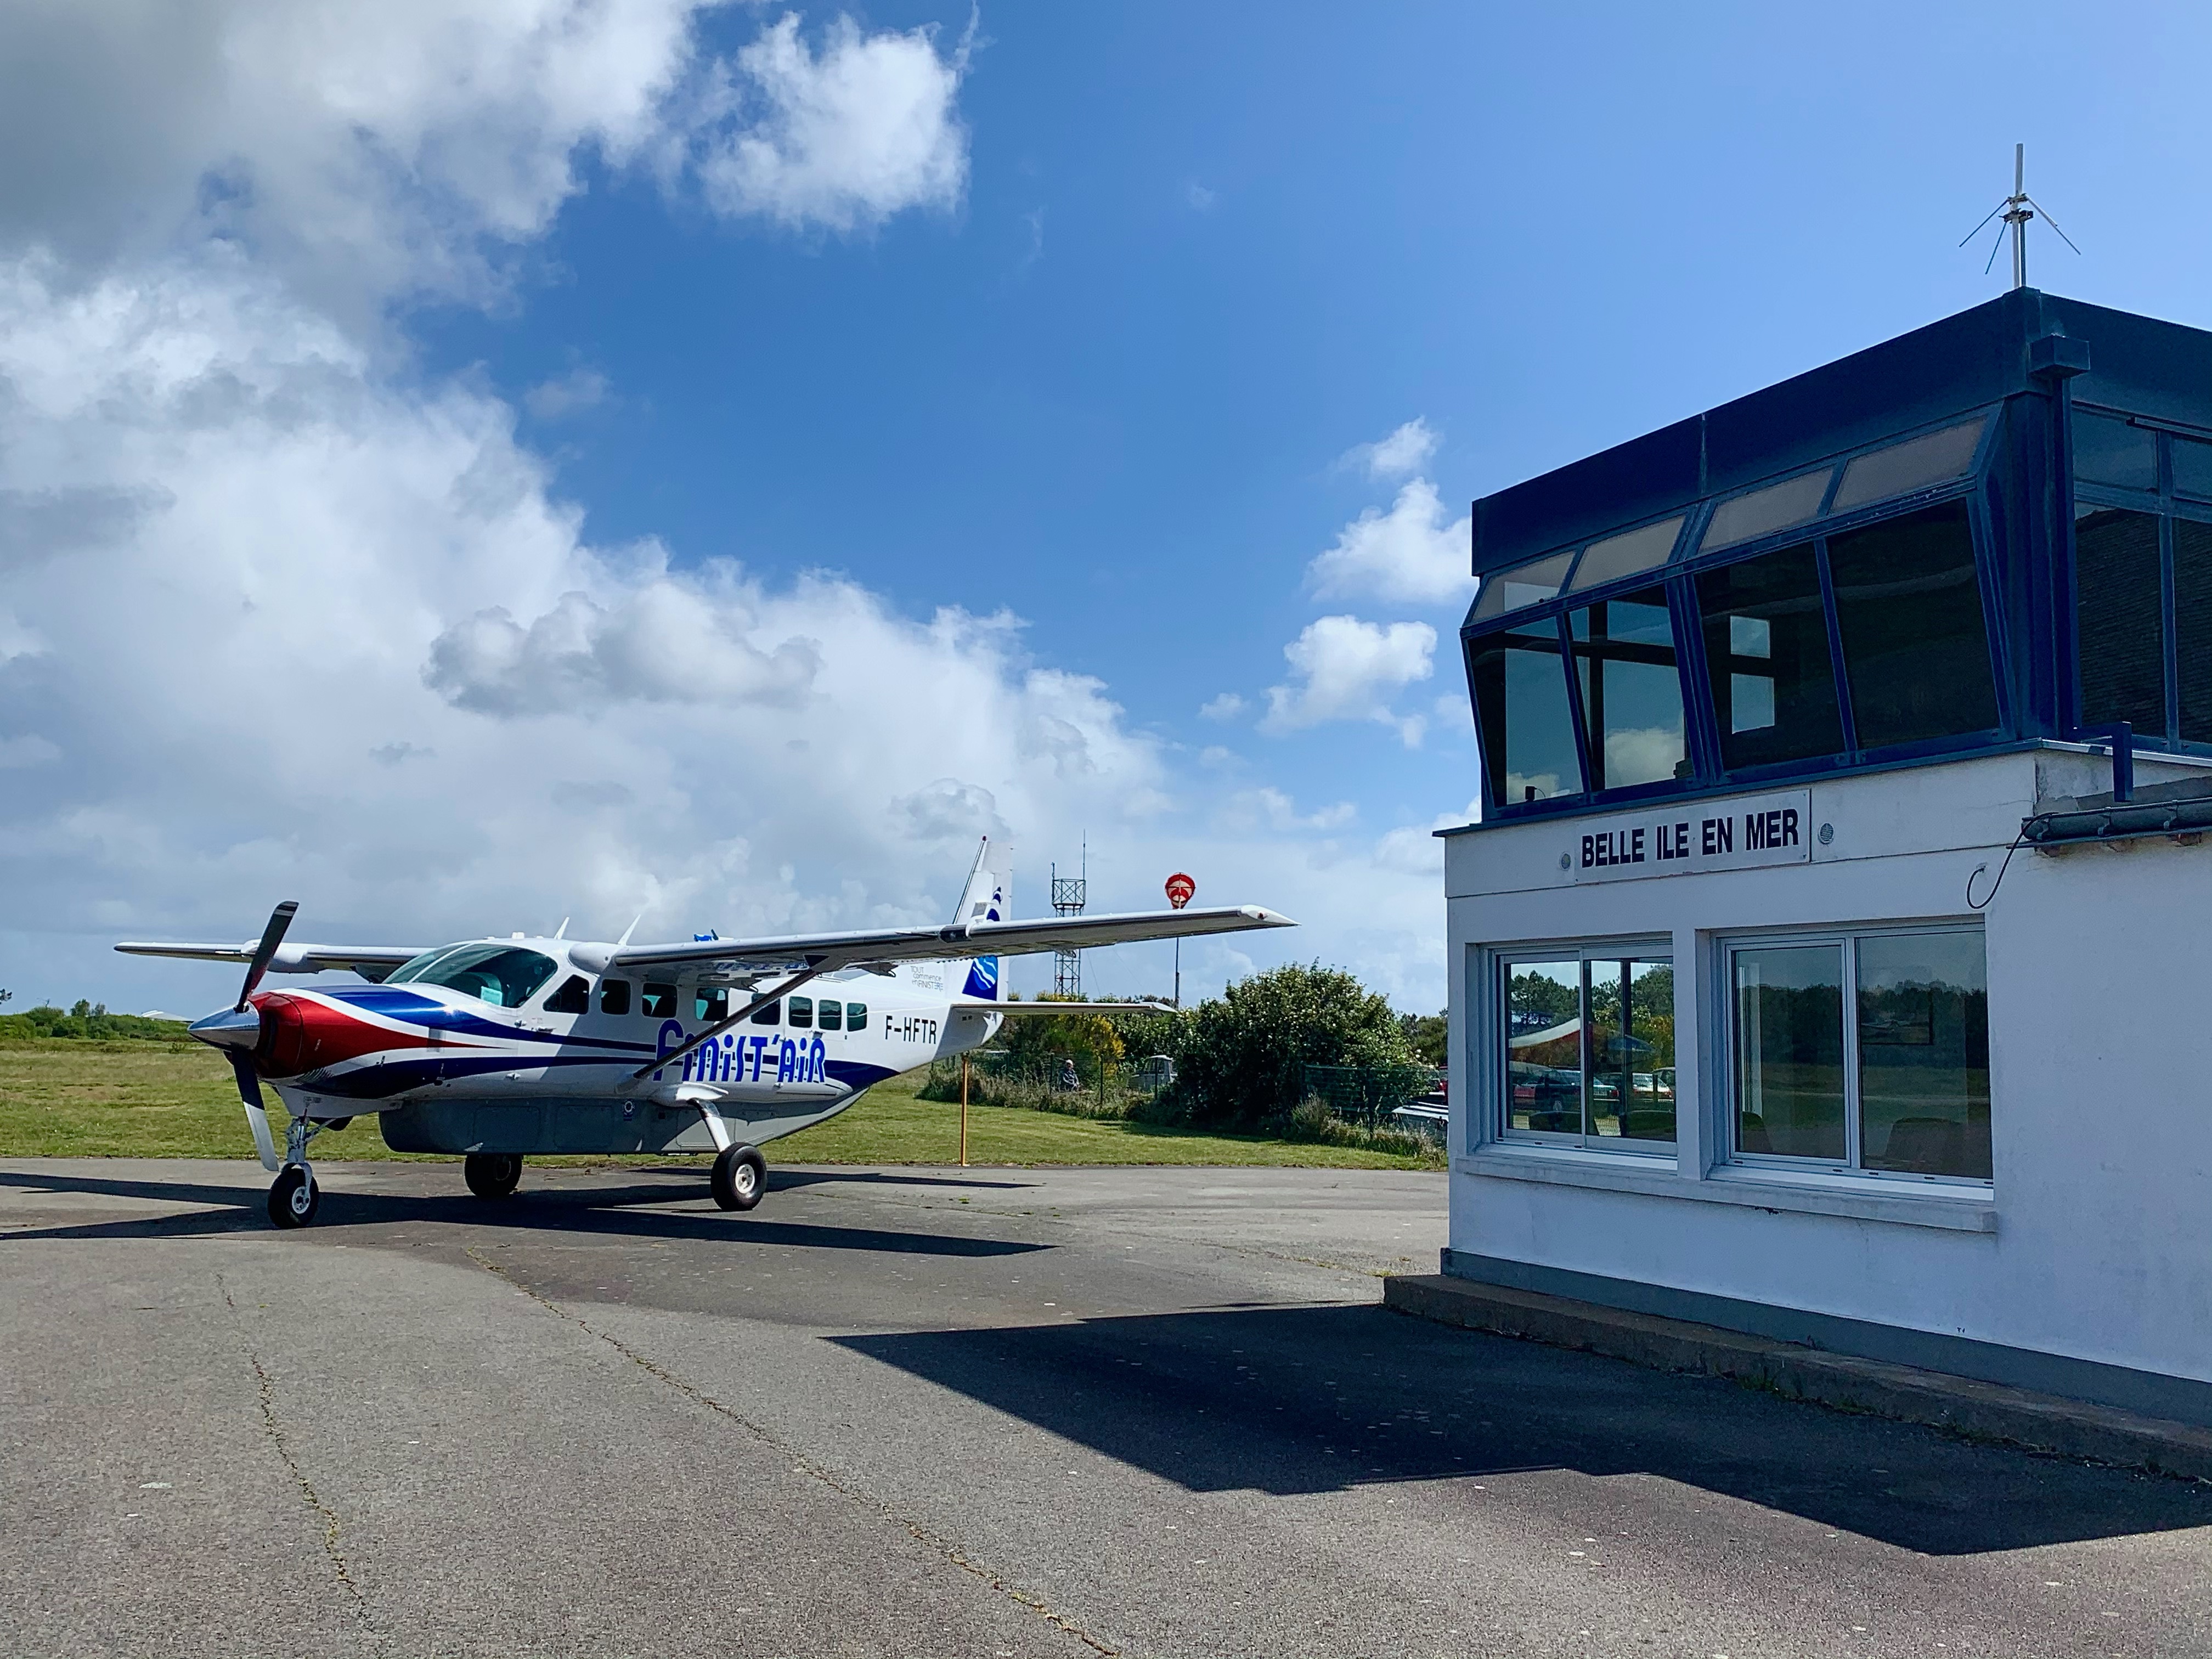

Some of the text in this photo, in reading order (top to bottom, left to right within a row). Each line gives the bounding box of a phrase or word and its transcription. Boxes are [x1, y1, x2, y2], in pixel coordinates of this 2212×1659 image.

[1582, 809, 1799, 868] BELLE ILE EN MER
[910, 966, 924, 974] TOUT
[885, 1015, 937, 1045] F-HFTR
